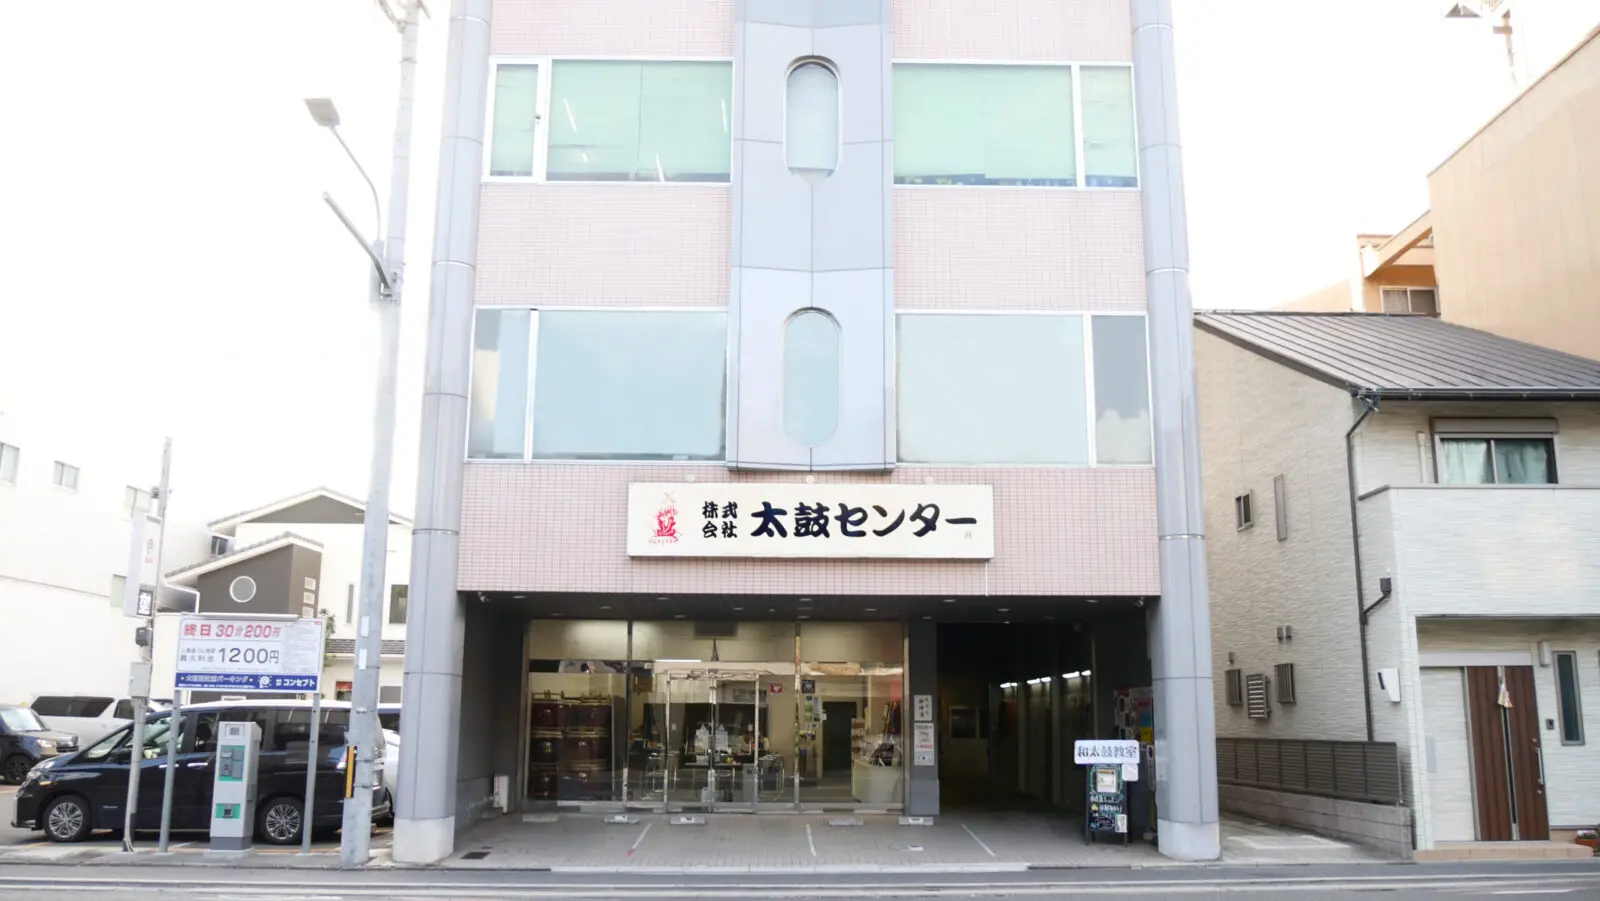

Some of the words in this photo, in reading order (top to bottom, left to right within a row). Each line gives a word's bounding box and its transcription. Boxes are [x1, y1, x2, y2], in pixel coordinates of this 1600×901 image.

[702, 501, 738, 519] 株式
[750, 501, 978, 539] 太鼓センター
[702, 520, 738, 538] 会社
[183, 623, 211, 637] 終日
[218, 648, 280, 664] 1200円
[283, 678, 315, 687] コンセプト
[1077, 745, 1138, 759] 和太鼓教室
